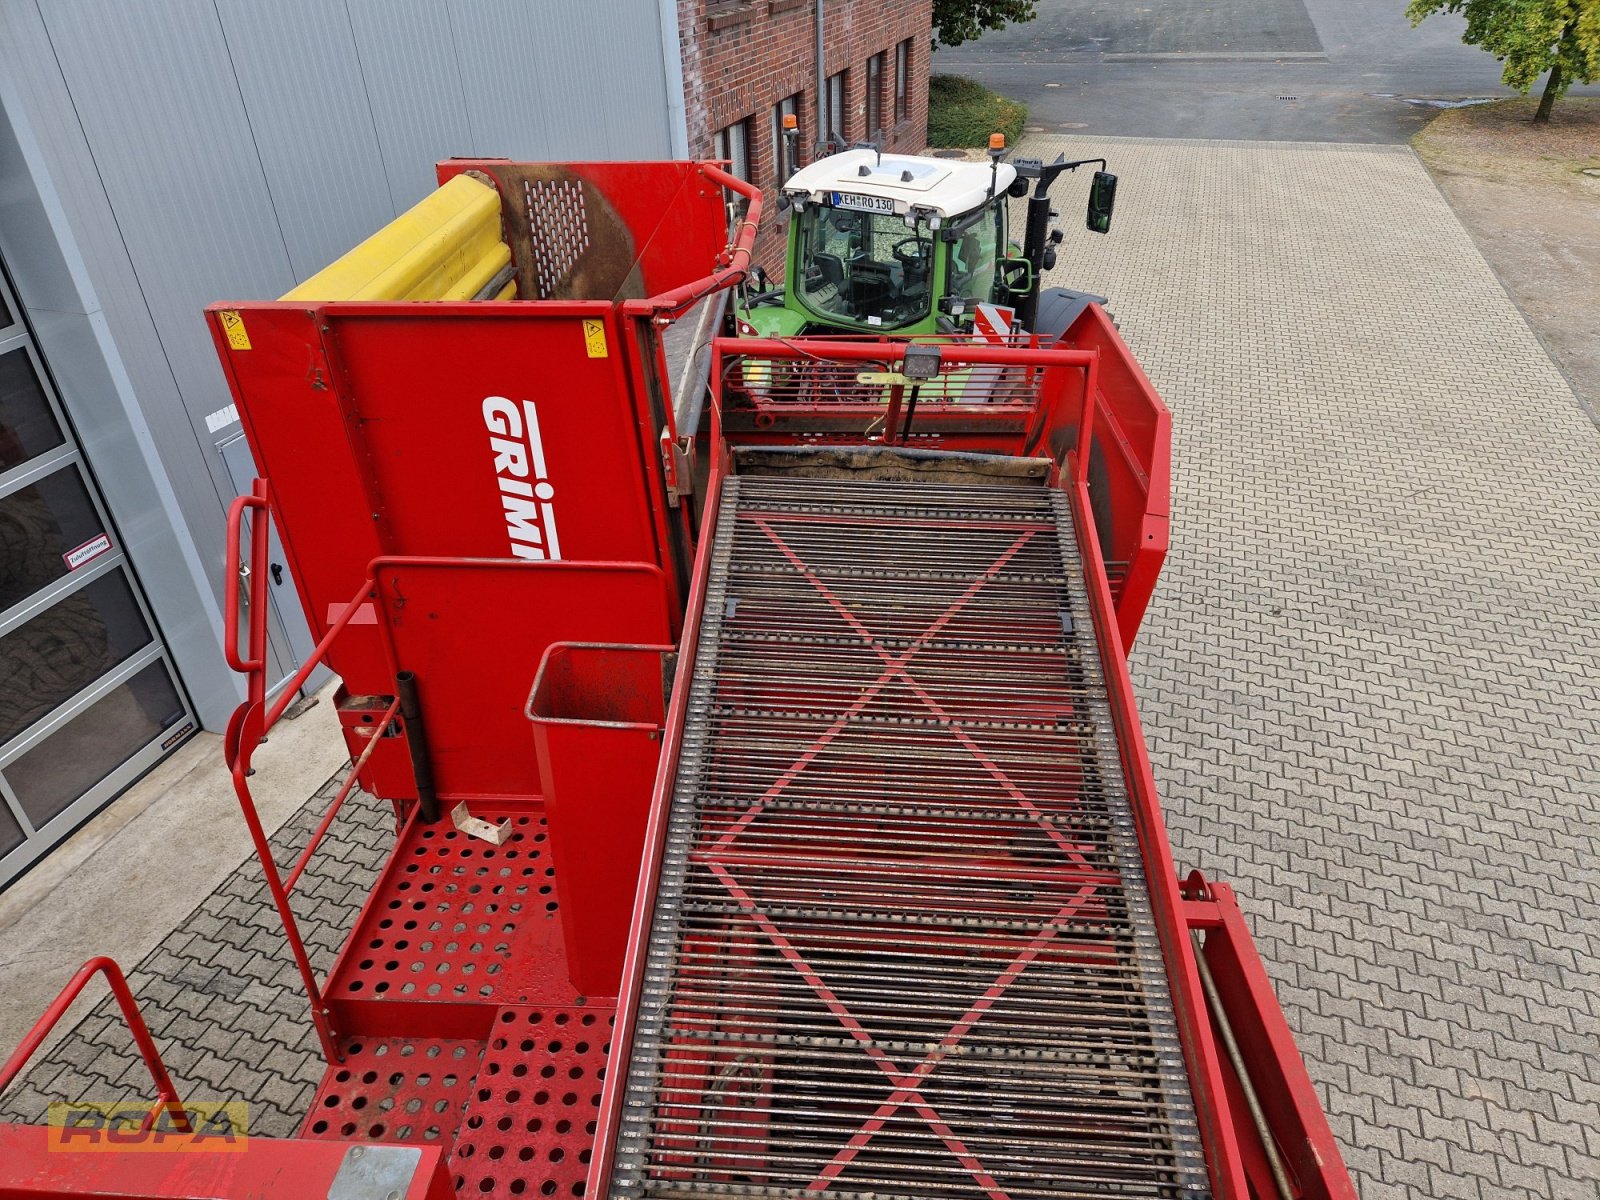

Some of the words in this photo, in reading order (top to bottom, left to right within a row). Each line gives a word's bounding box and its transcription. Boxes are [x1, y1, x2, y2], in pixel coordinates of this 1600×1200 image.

[839, 193, 856, 206] KEH
[862, 197, 874, 208] RO
[876, 199, 893, 211] 130
